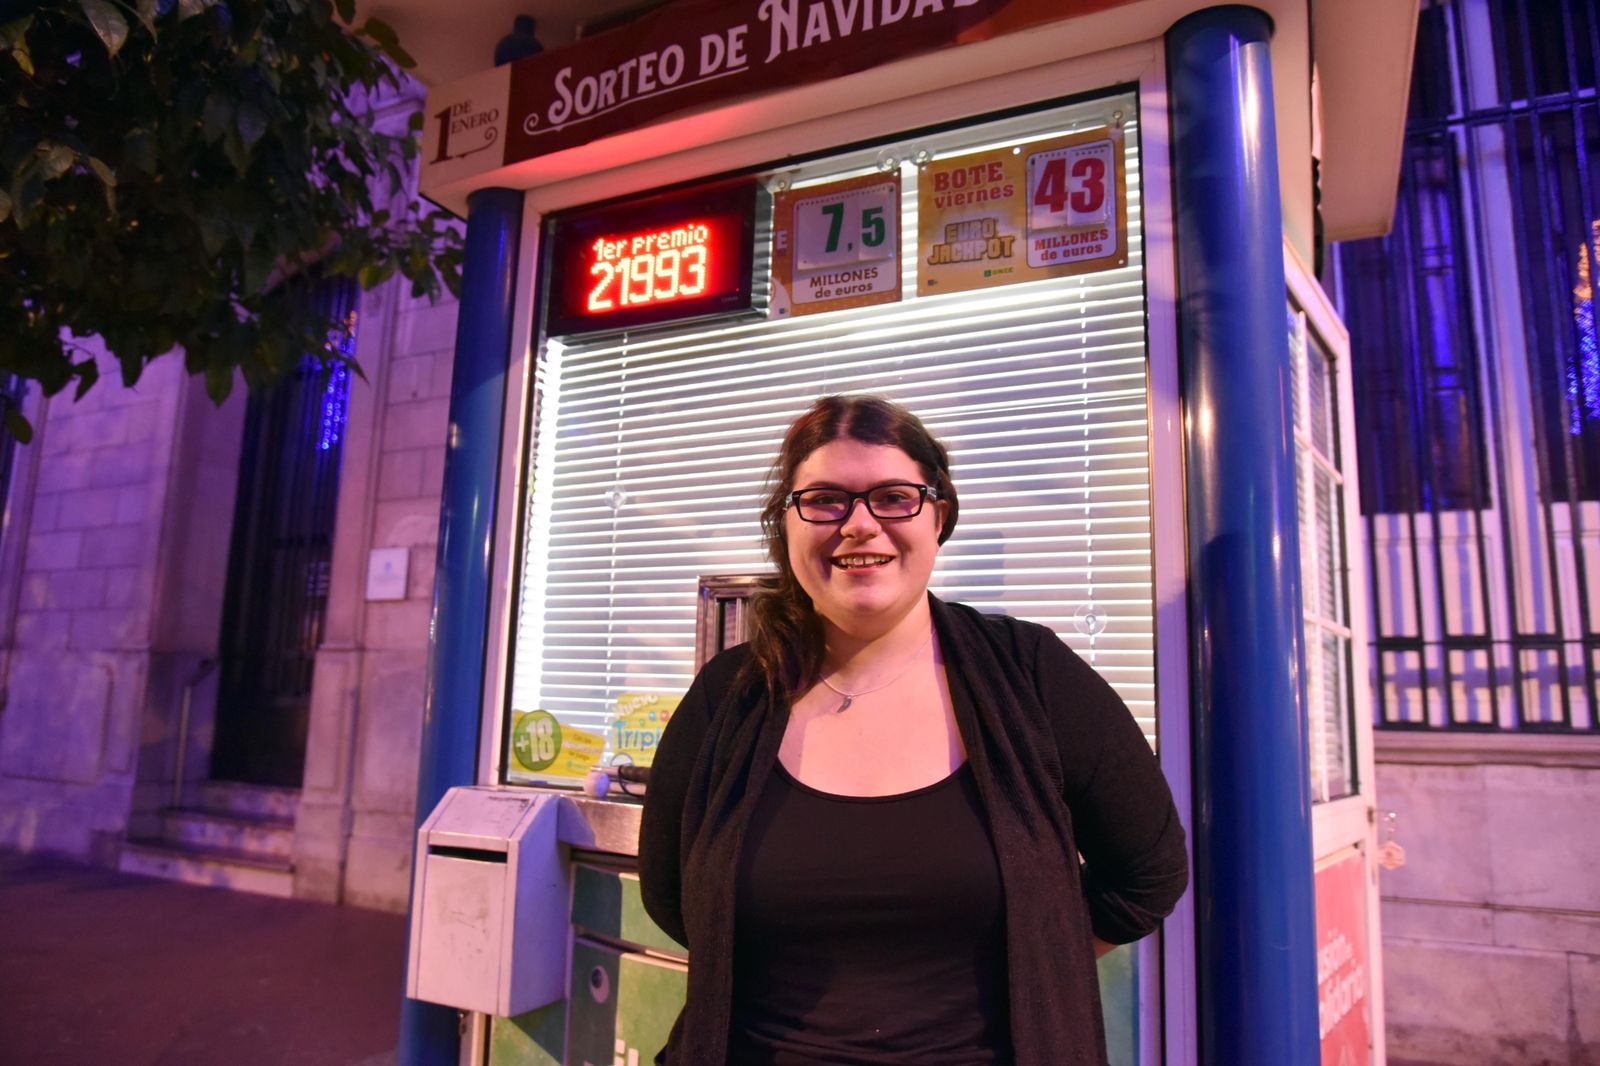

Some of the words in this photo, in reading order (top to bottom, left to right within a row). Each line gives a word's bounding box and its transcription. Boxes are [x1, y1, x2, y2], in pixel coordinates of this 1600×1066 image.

[547, 45, 685, 125] SORTEO
[699, 24, 748, 76] DE
[758, 0, 980, 63] NAVID
[429, 105, 453, 165] 1
[451, 99, 472, 117] DE
[450, 108, 499, 134] ENERO
[934, 161, 1003, 193] BOTE
[1034, 157, 1105, 213] 43
[934, 184, 1014, 209] viernes
[944, 217, 997, 245] EURO
[1034, 228, 1109, 251] MILLONES
[592, 238, 627, 261] 1er
[927, 235, 1015, 265] JACKPOT
[1040, 249, 1058, 261] de
[1062, 244, 1103, 258] euros
[587, 245, 707, 311] 21993
[809, 266, 879, 289] MILLONES
[814, 287, 832, 299] de
[835, 282, 873, 296] euros
[515, 717, 555, 763] +18
[611, 719, 664, 752] Tripl
